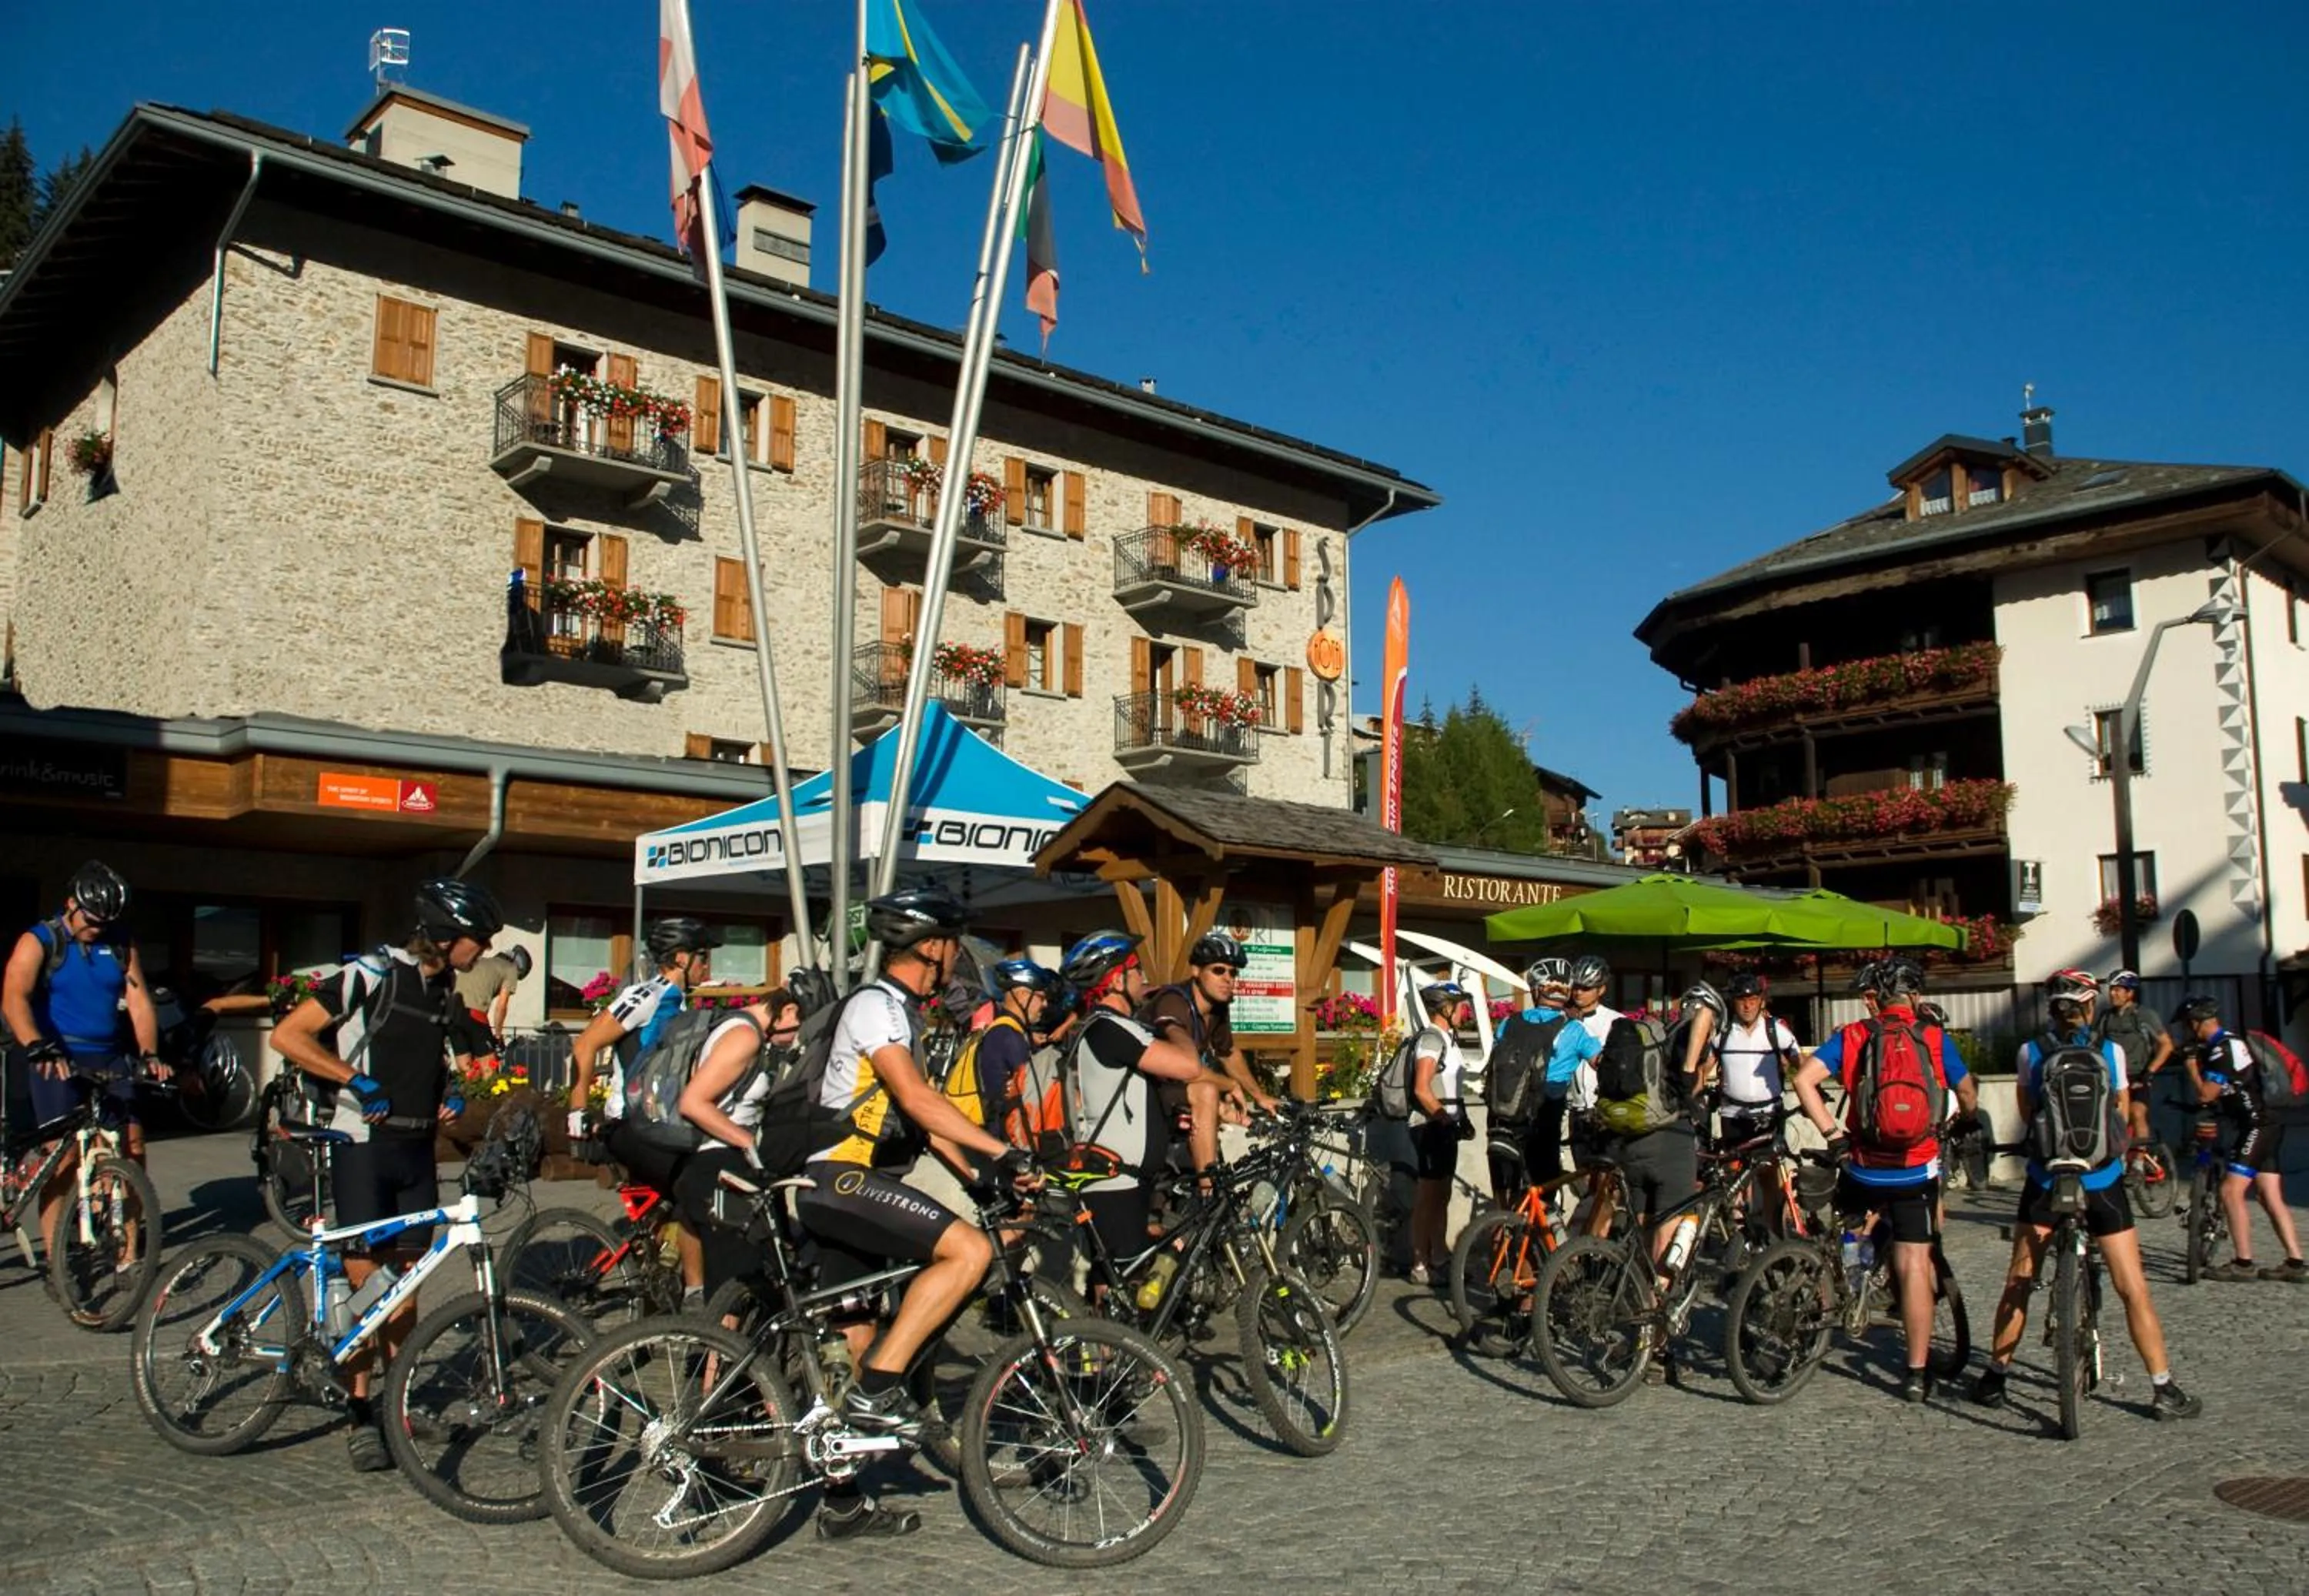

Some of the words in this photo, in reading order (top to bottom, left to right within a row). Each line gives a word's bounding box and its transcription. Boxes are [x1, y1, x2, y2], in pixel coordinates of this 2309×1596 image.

[667, 829, 782, 866] BIONICON
[1443, 875, 1562, 905] RISTORANTE
[855, 1184, 941, 1220] LIVESTRONG
